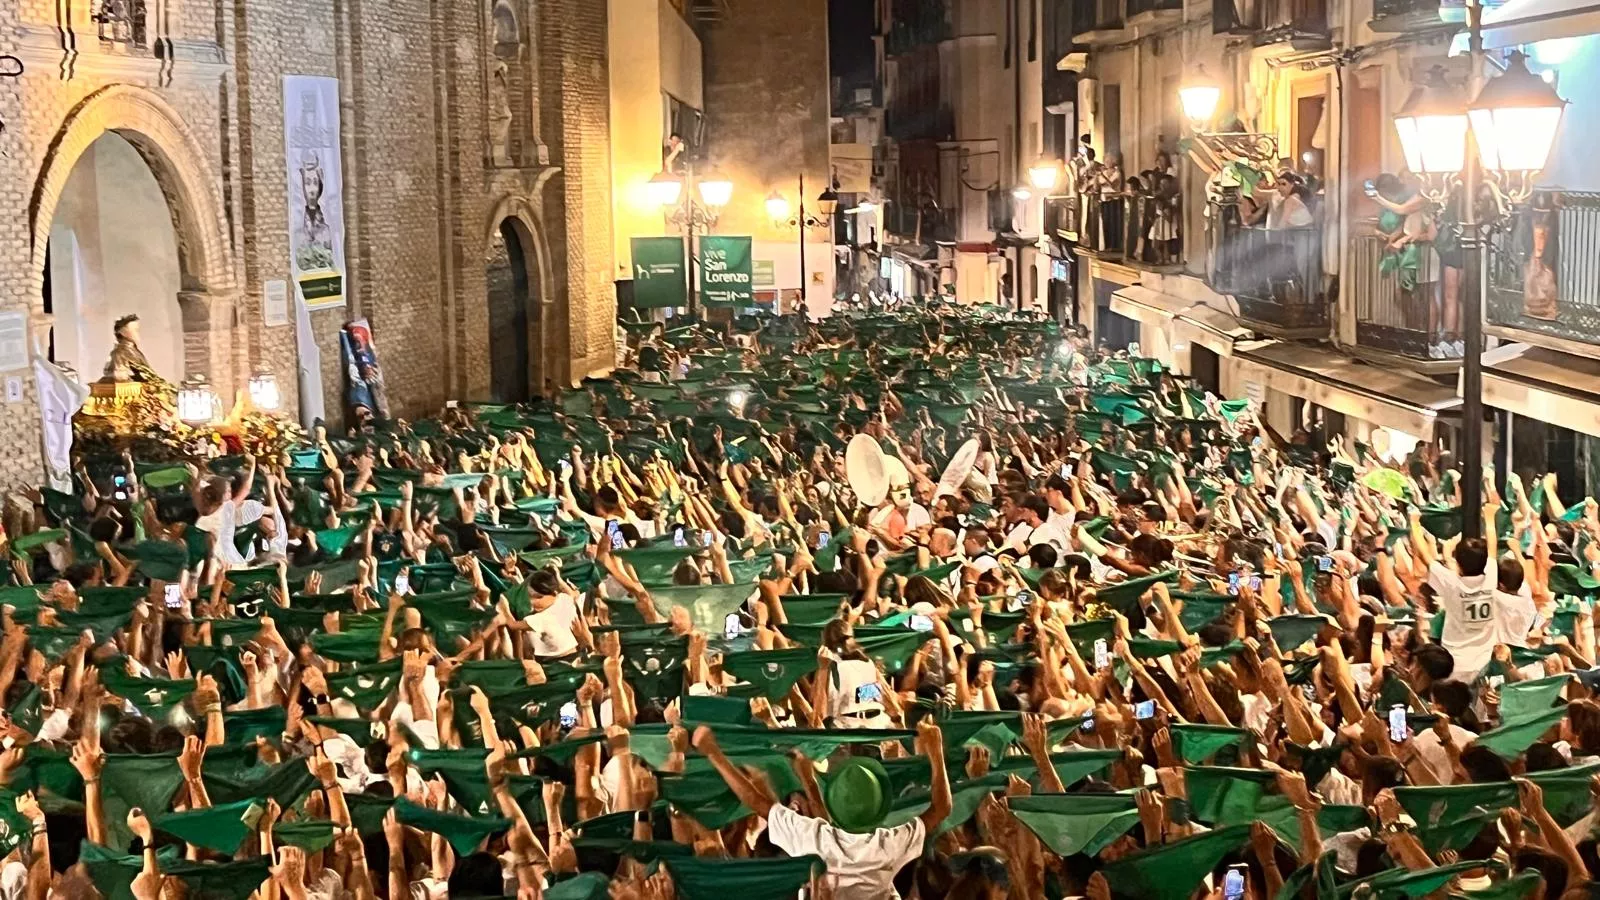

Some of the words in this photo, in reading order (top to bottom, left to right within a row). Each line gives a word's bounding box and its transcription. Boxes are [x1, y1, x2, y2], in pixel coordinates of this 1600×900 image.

[704, 258, 727, 271] San
[705, 271, 750, 283] Lorenzo
[1466, 603, 1491, 620] 10
